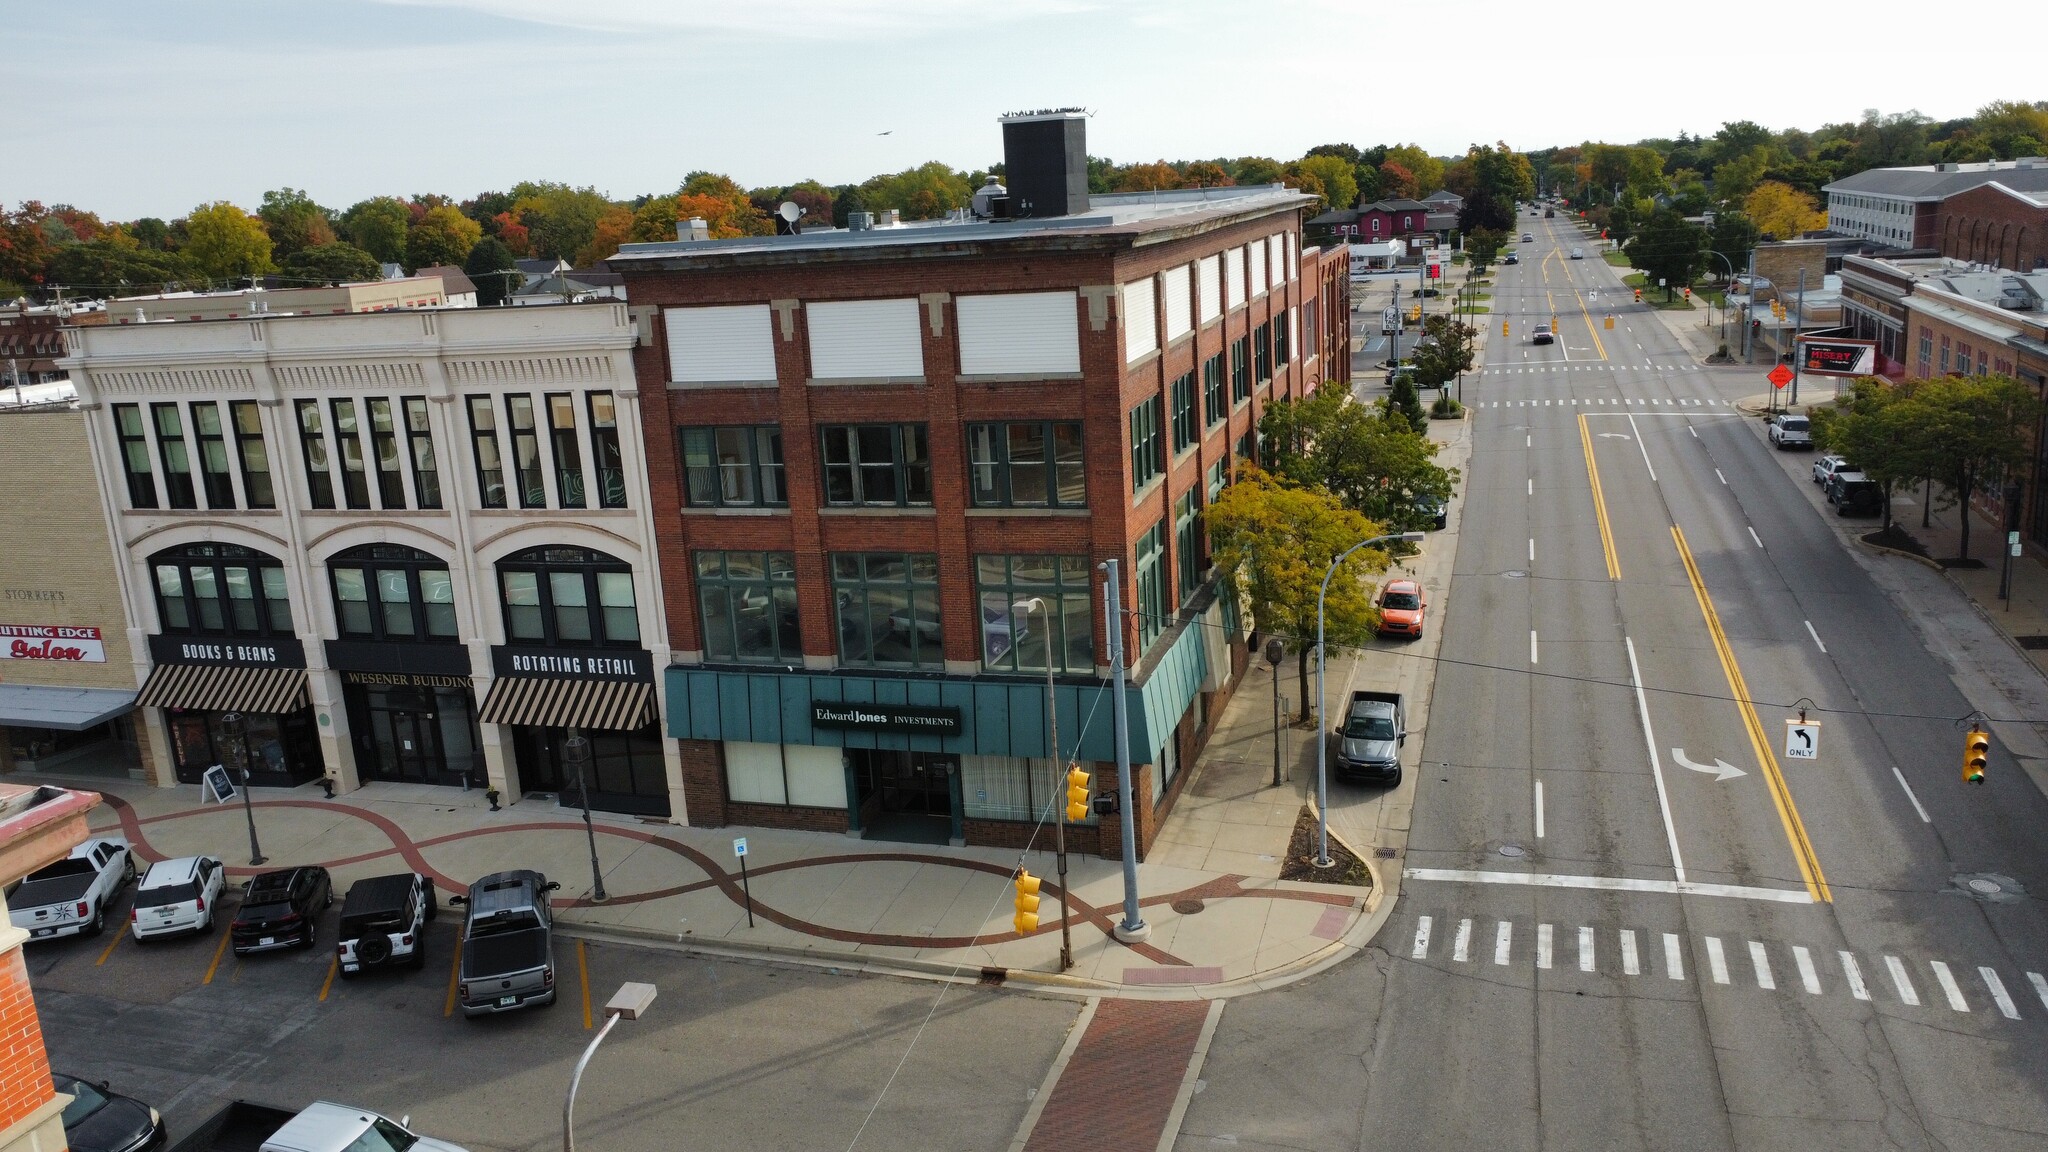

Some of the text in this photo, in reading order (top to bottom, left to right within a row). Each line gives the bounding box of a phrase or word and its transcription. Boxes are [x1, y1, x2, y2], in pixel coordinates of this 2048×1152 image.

[1811, 351, 1851, 361] MISERY
[57, 627, 96, 639] EDGE
[10, 639, 87, 660] Salon
[182, 644, 276, 662] BOOKS & BEANS
[512, 655, 636, 675] ROTATING RETAIL
[348, 672, 409, 686] WESENER
[894, 715, 955, 727] INVESTMENTS
[1789, 748, 1814, 757] ONLY
